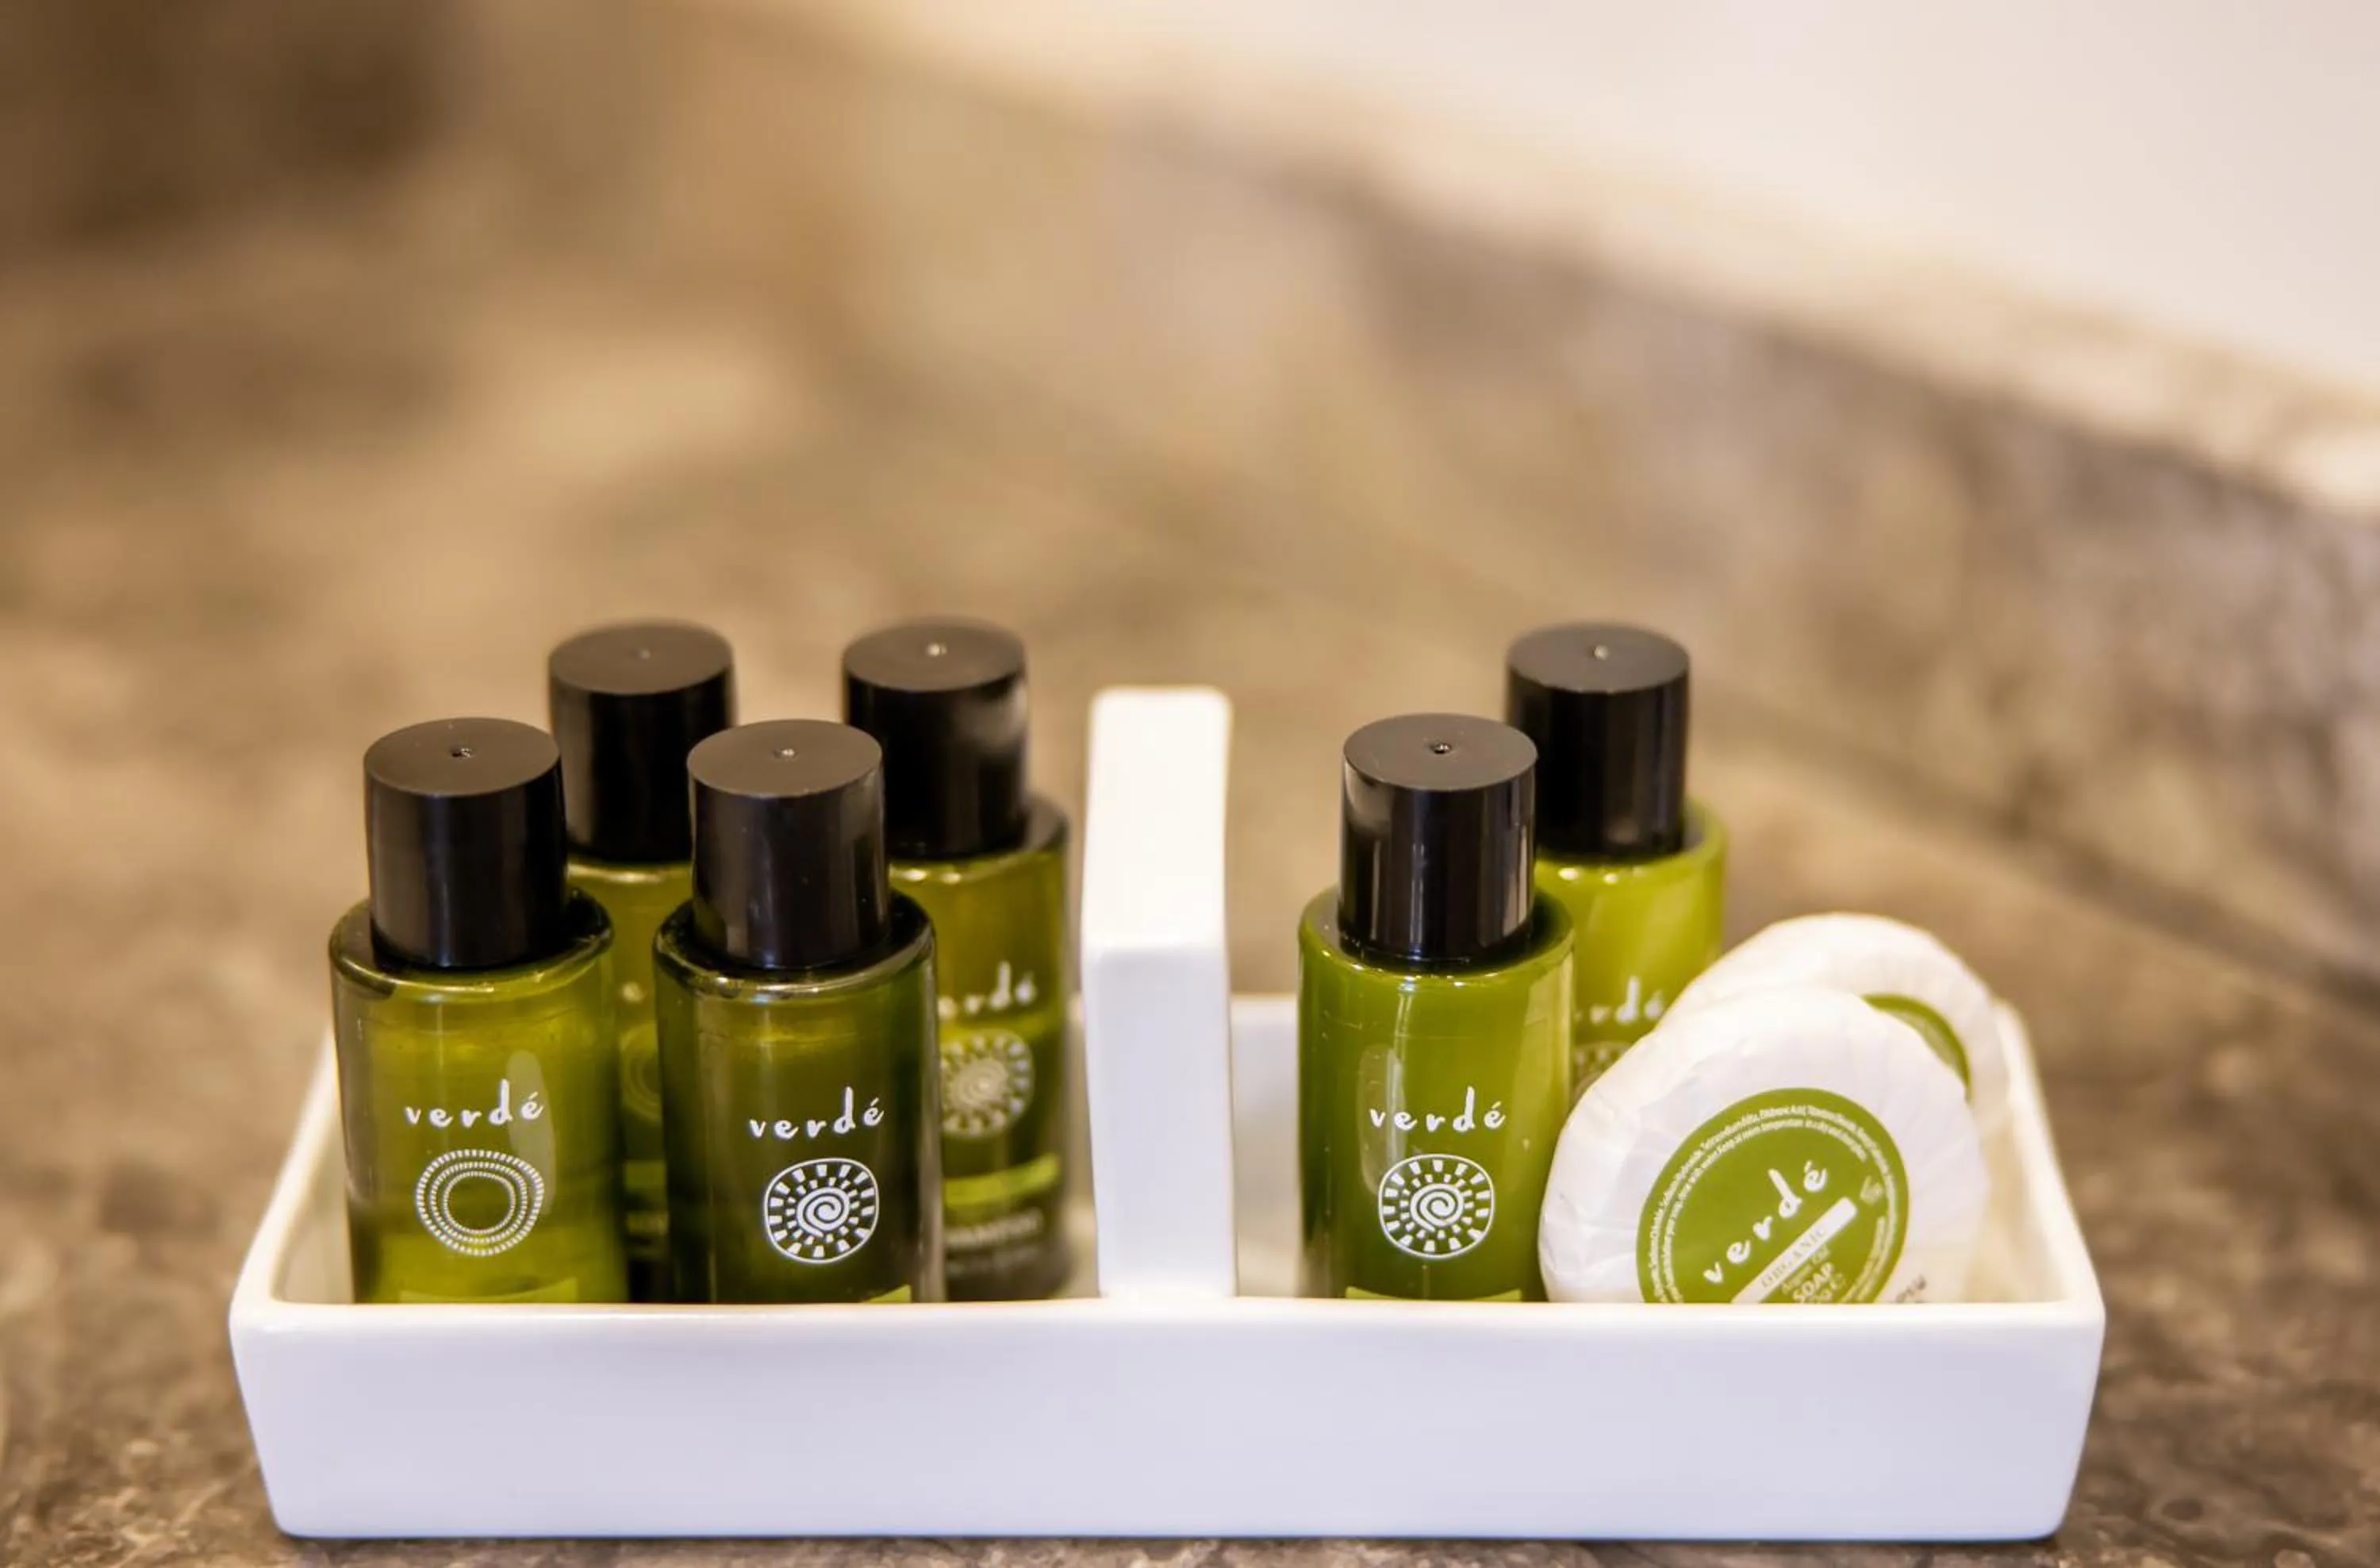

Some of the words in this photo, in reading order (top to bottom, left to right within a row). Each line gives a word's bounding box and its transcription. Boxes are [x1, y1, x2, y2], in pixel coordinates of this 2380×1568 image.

[938, 961, 1037, 1020] erdé
[404, 1078, 544, 1126] verdé
[749, 1086, 885, 1139] verdé
[1369, 1086, 1507, 1133] verdé
[1702, 1160, 1828, 1283] verdé
[1791, 1261, 1835, 1303] SOAP
